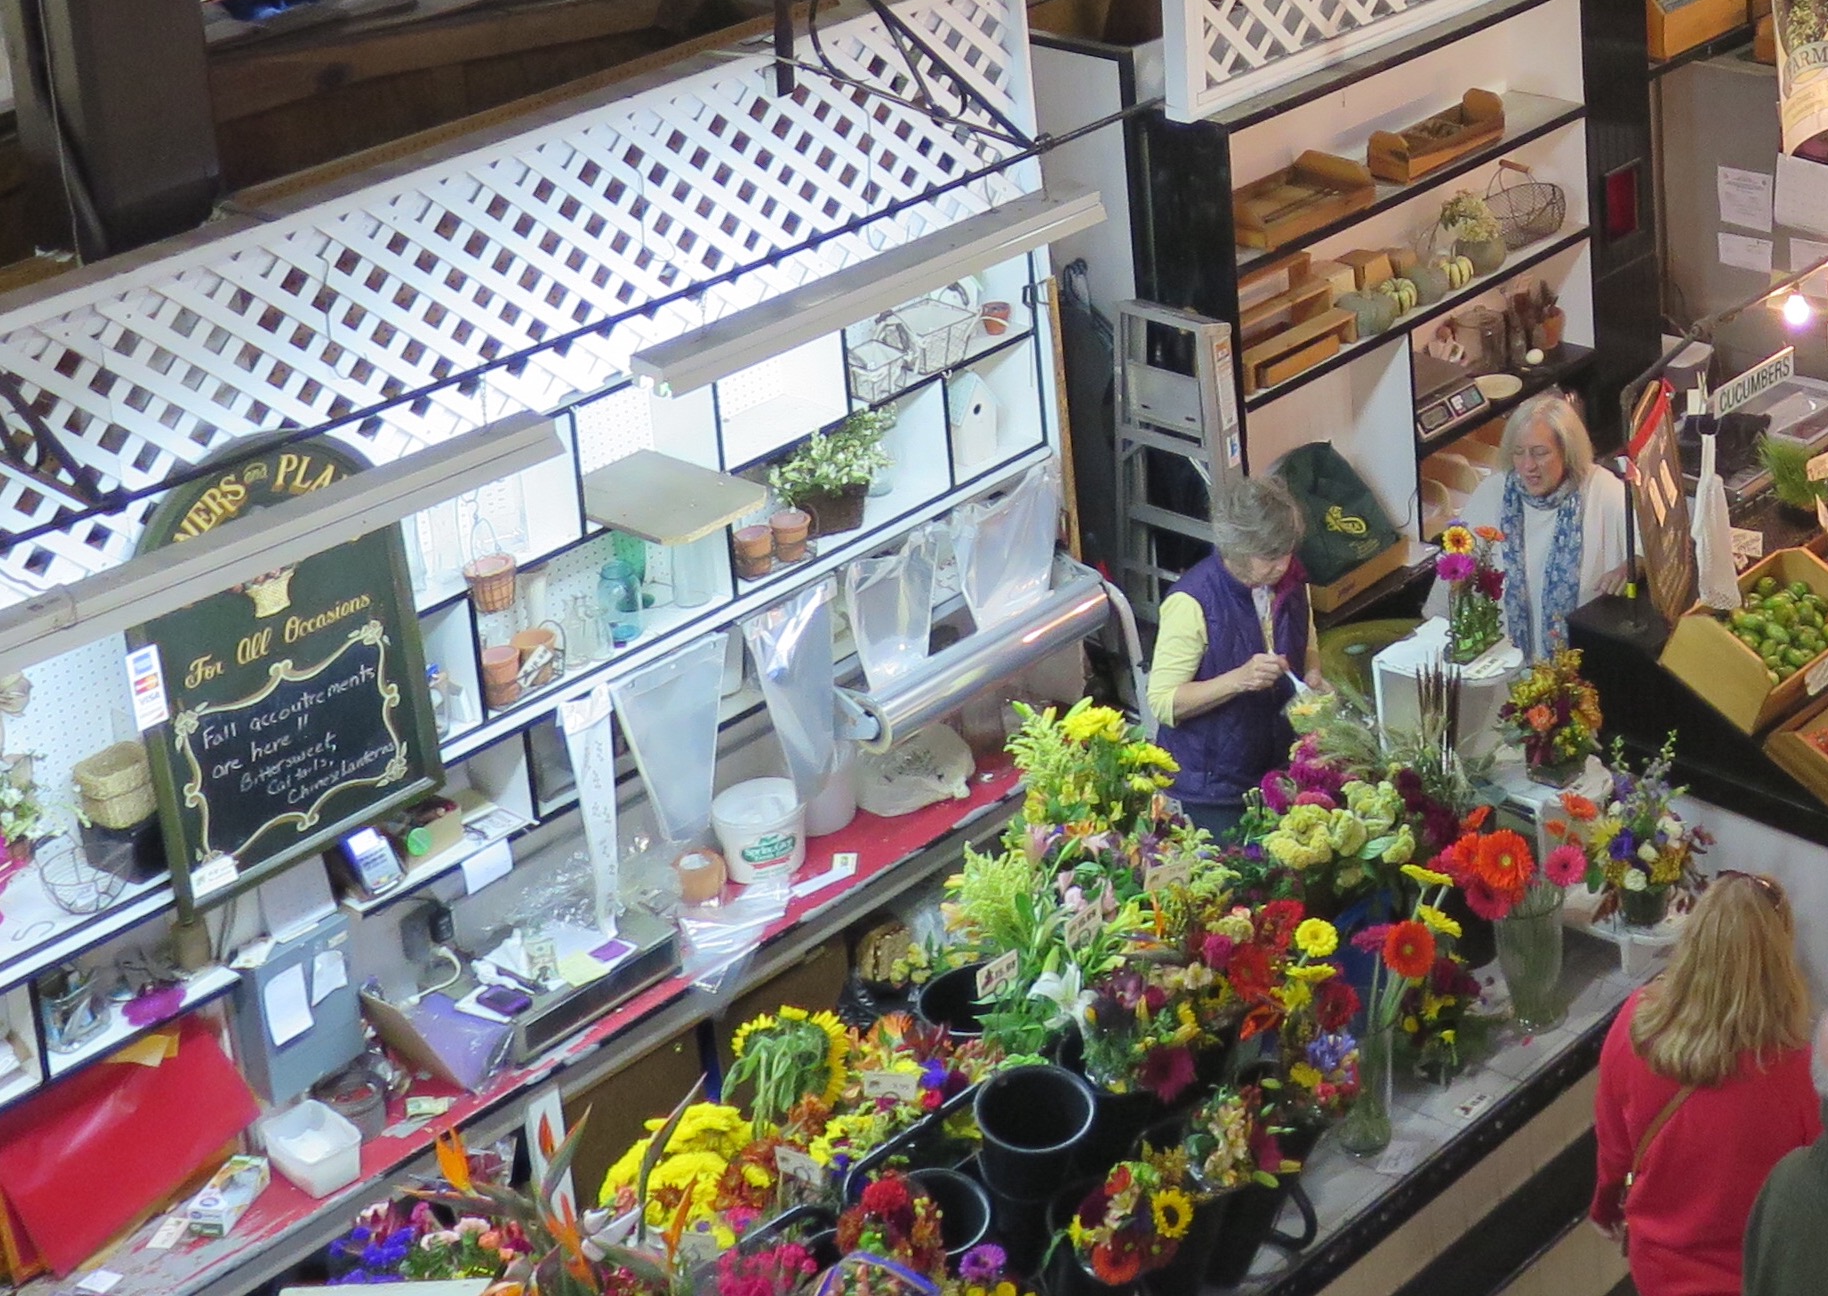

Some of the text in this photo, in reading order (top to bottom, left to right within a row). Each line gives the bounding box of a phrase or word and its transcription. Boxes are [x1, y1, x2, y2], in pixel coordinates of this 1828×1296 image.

[1718, 359, 1791, 414] CUCUMBERS
[243, 462, 269, 484] and
[184, 593, 371, 691] For All Occasions
[138, 691, 161, 705] VISA
[202, 718, 238, 751] Fall
[211, 756, 243, 781] are
[250, 733, 292, 759] here
[266, 777, 291, 797] Cat
